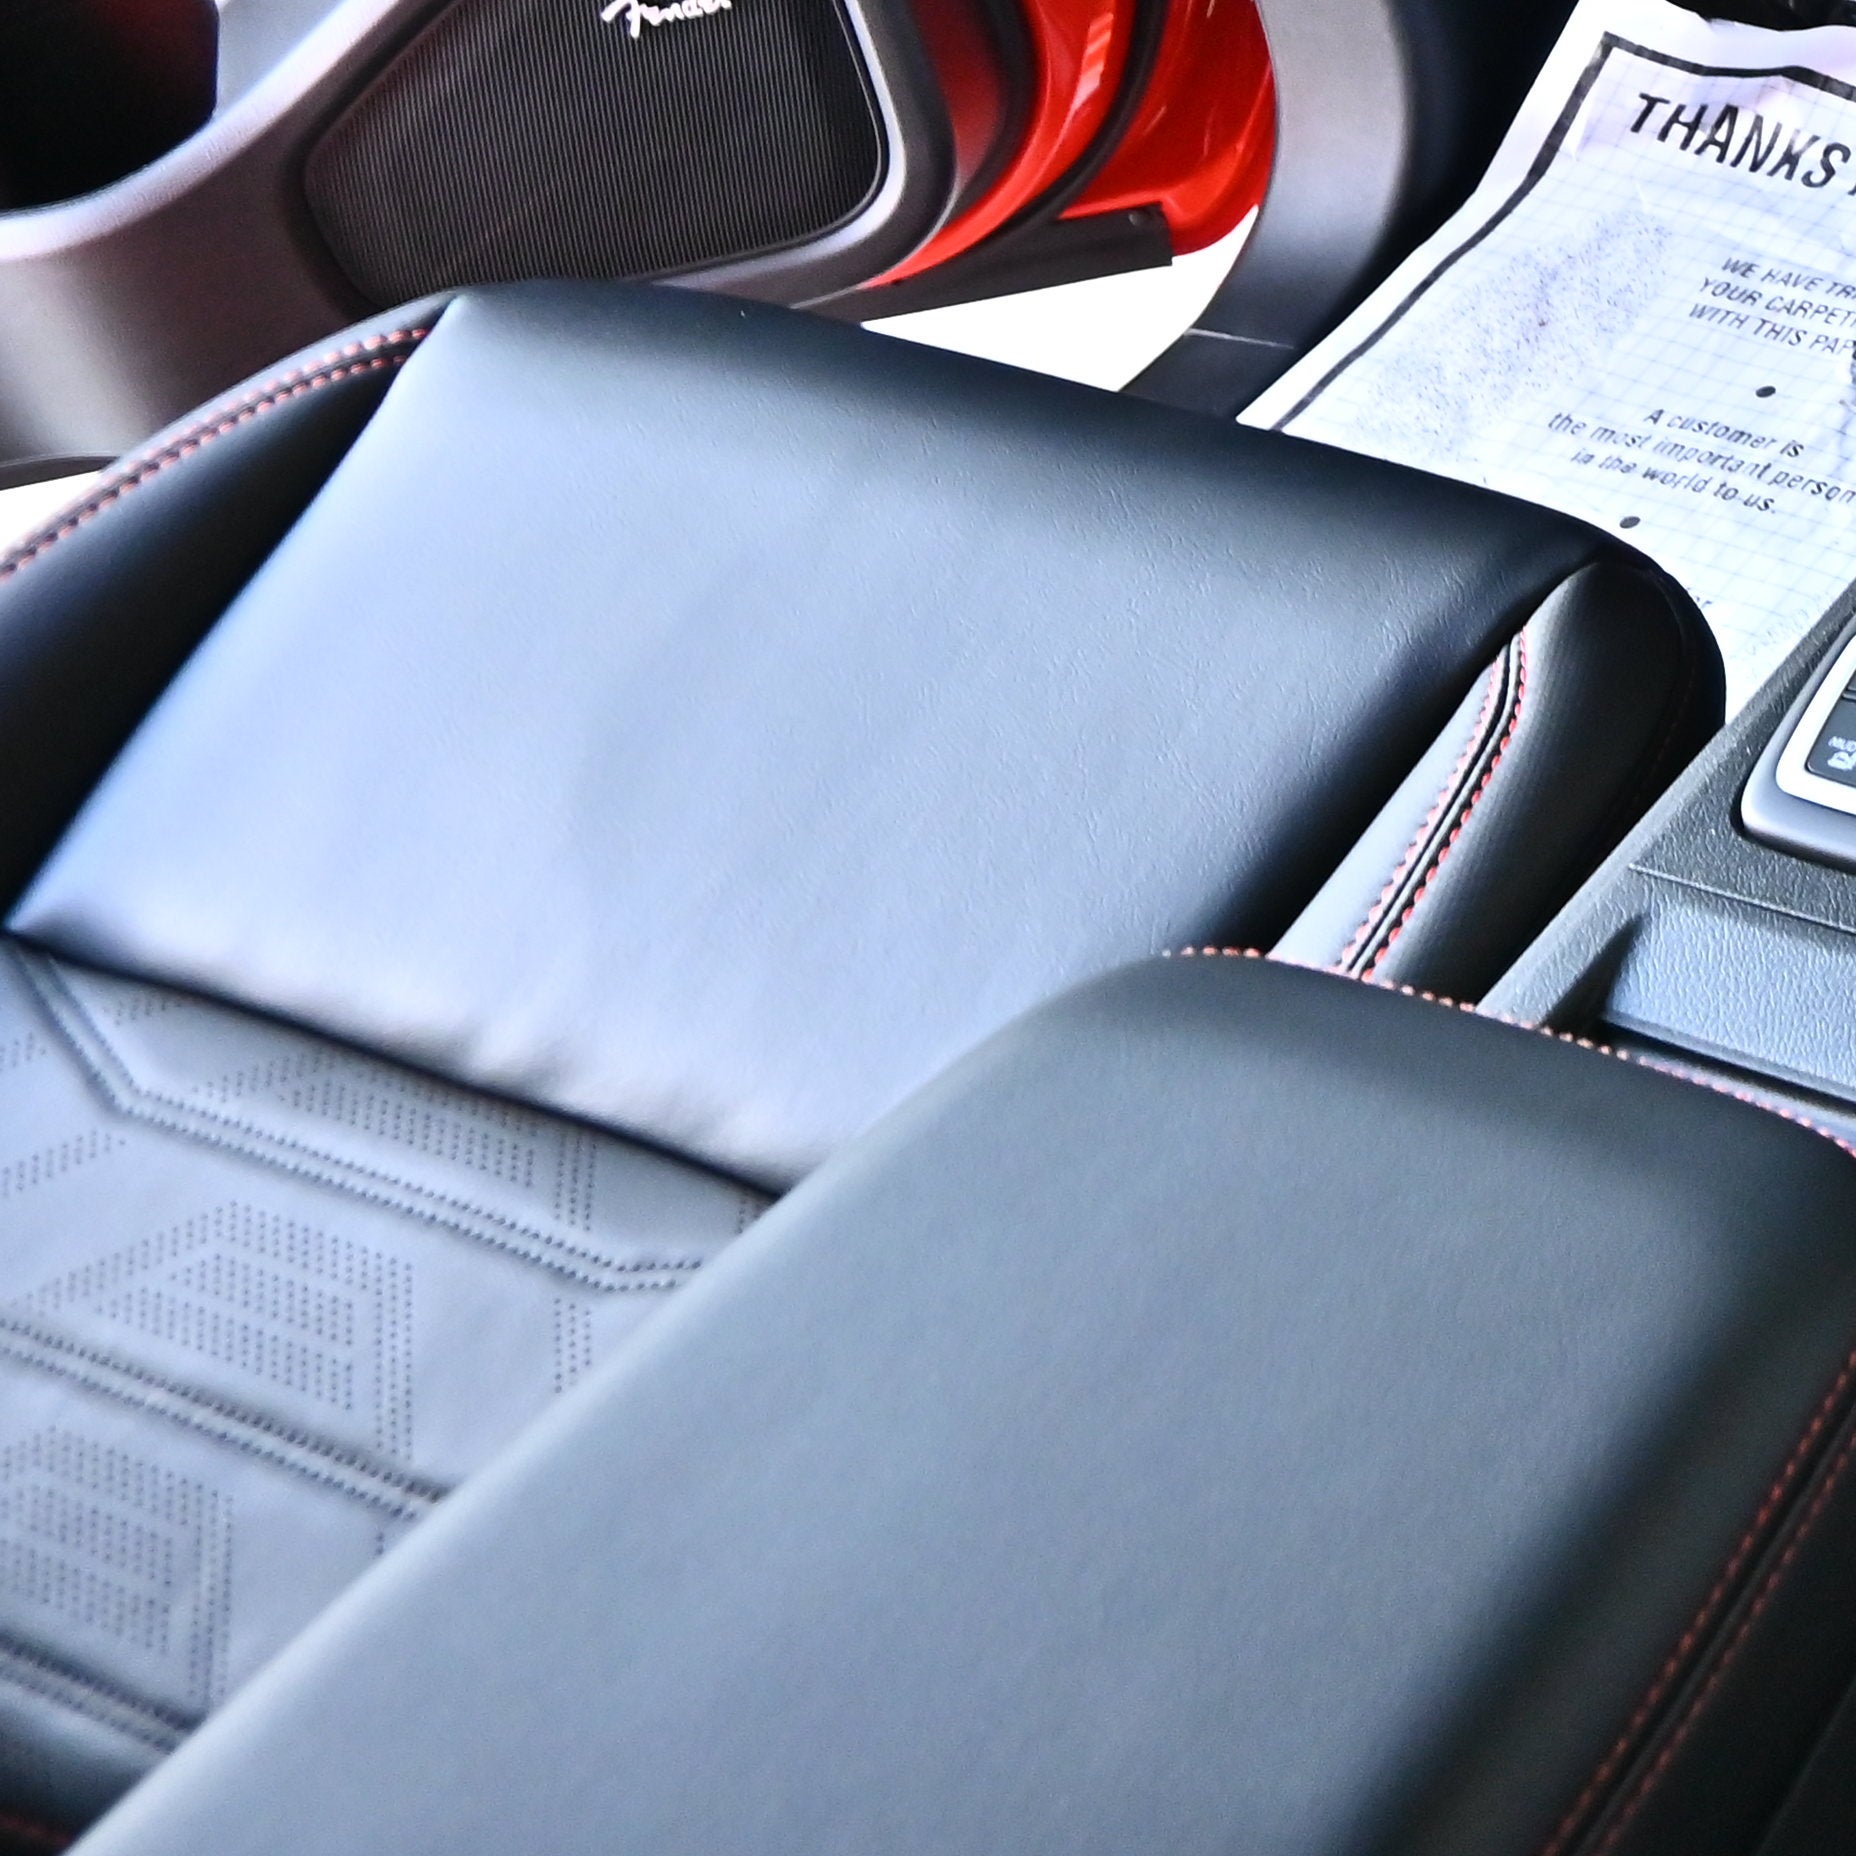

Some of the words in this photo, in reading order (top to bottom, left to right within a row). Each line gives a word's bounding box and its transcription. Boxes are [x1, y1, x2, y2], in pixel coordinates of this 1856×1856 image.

[1629, 92, 1852, 189] THANKS
[1698, 276, 1764, 307] YOUR
[1721, 256, 1760, 279] WE
[1760, 268, 1824, 292] HAVE
[1688, 302, 1751, 330] WITH
[1752, 317, 1808, 347] THIS
[1547, 411, 1588, 437] the
[1589, 424, 1652, 451] most
[1651, 435, 1773, 480] important
[1643, 408, 1665, 426] A
[1666, 414, 1778, 450] customer
[1779, 438, 1805, 459] is
[1598, 453, 1638, 475] the
[1641, 466, 1714, 495] world
[1712, 479, 1740, 502] to
[1742, 492, 1778, 515] us.
